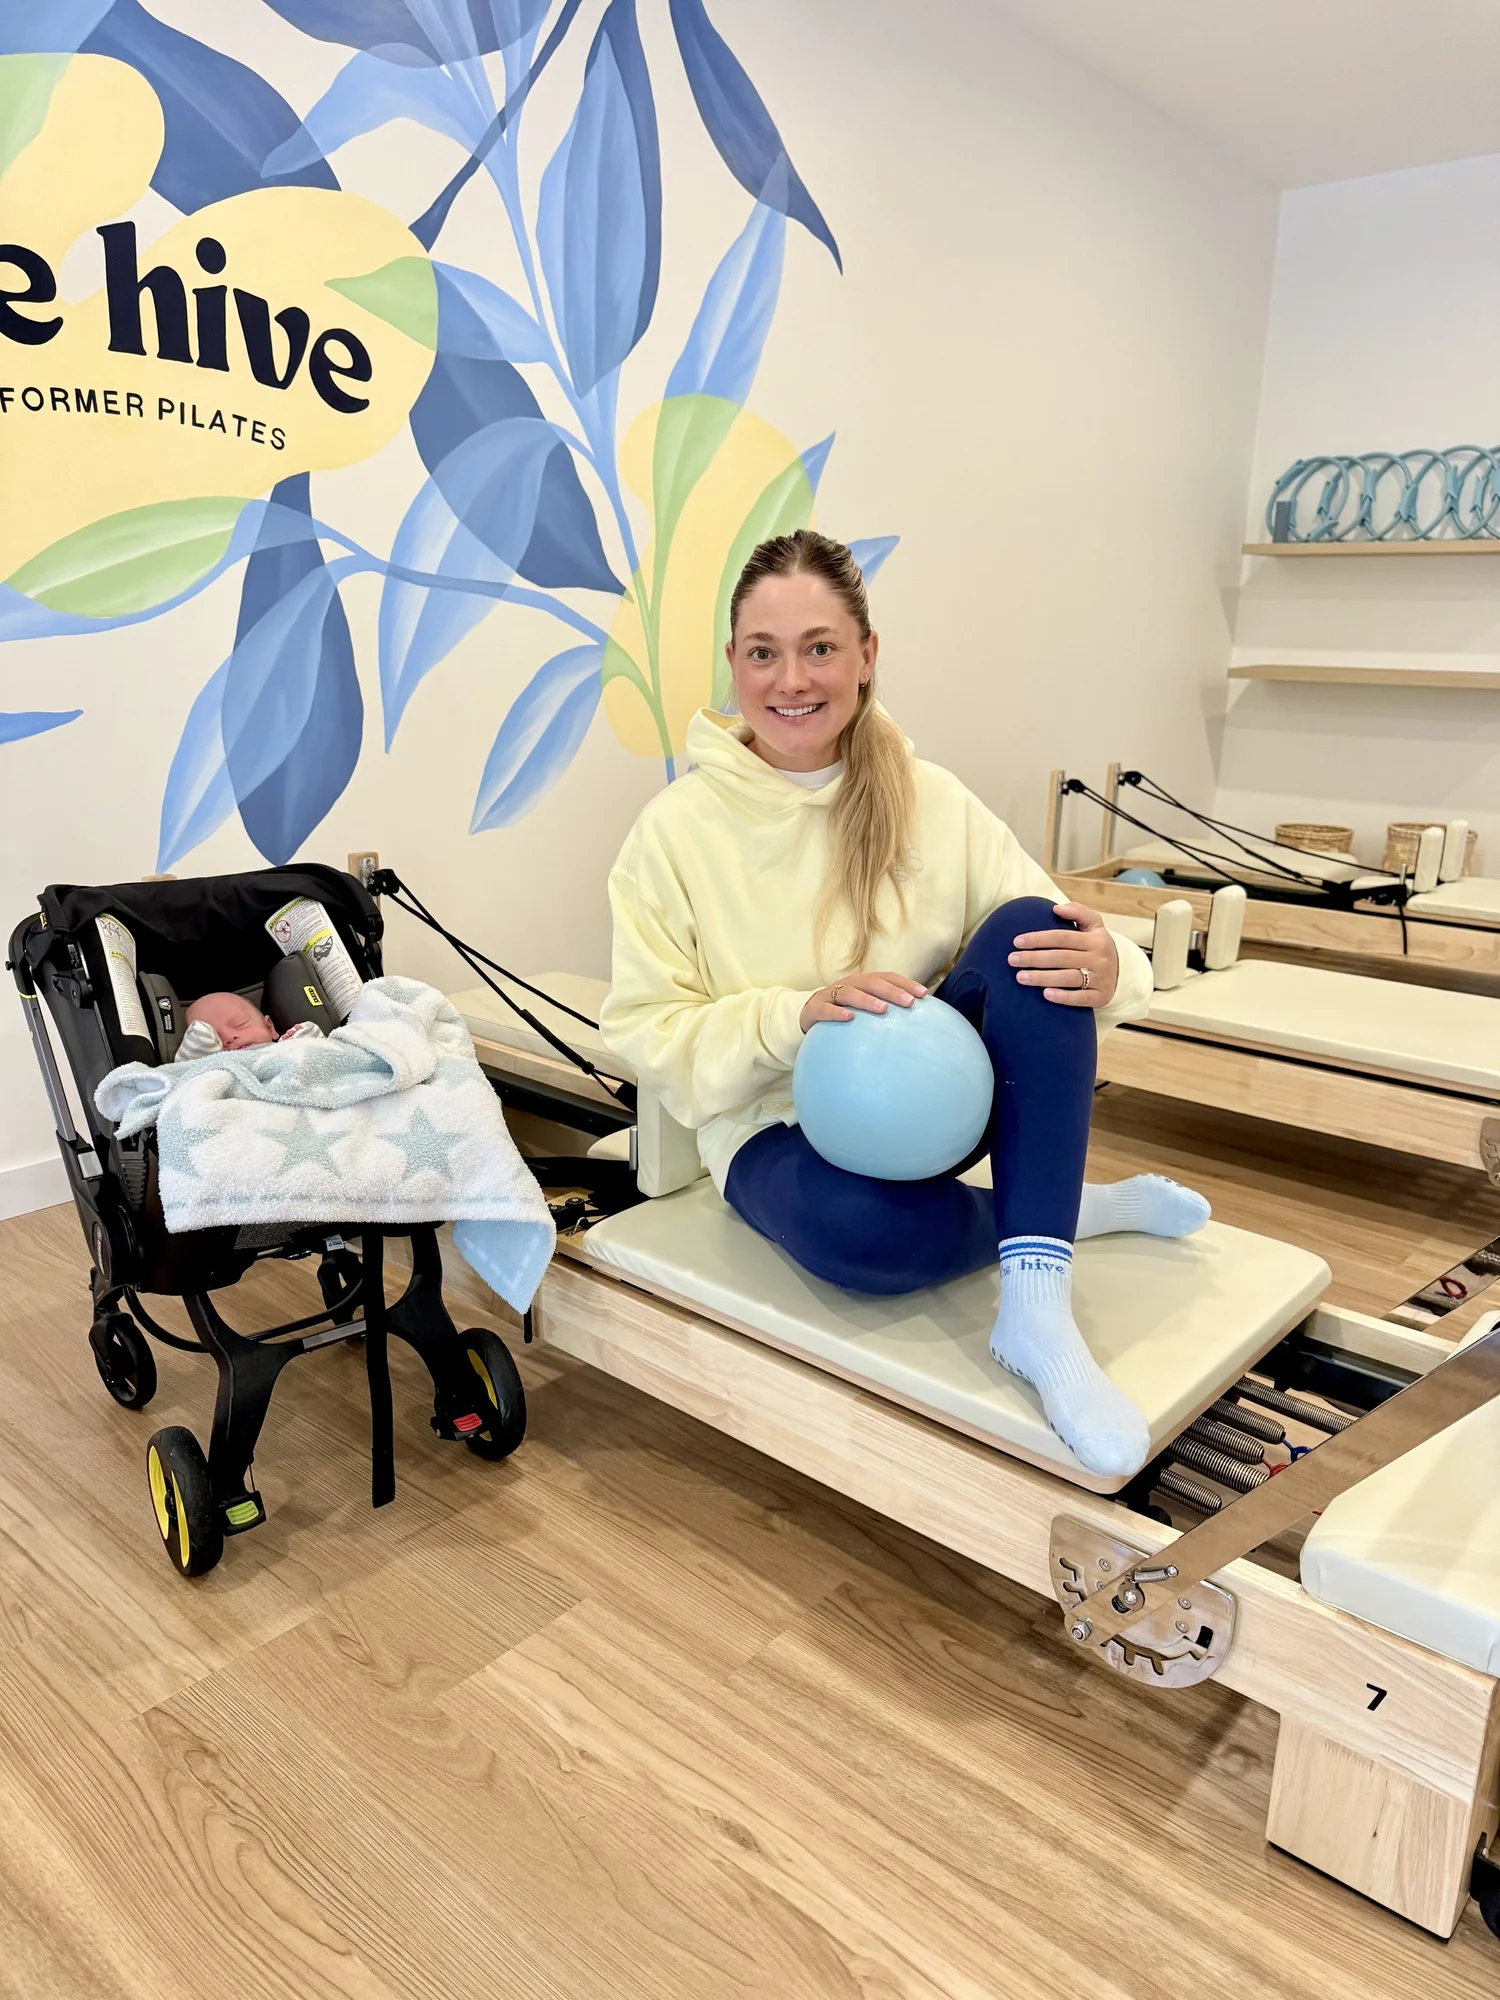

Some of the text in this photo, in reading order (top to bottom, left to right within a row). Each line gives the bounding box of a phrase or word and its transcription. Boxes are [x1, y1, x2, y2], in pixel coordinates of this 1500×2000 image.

[96, 221, 373, 414] hive
[0, 387, 287, 450] FORMER PILATES
[1020, 1258, 1064, 1274] hive
[1366, 1682, 1388, 1711] 7
